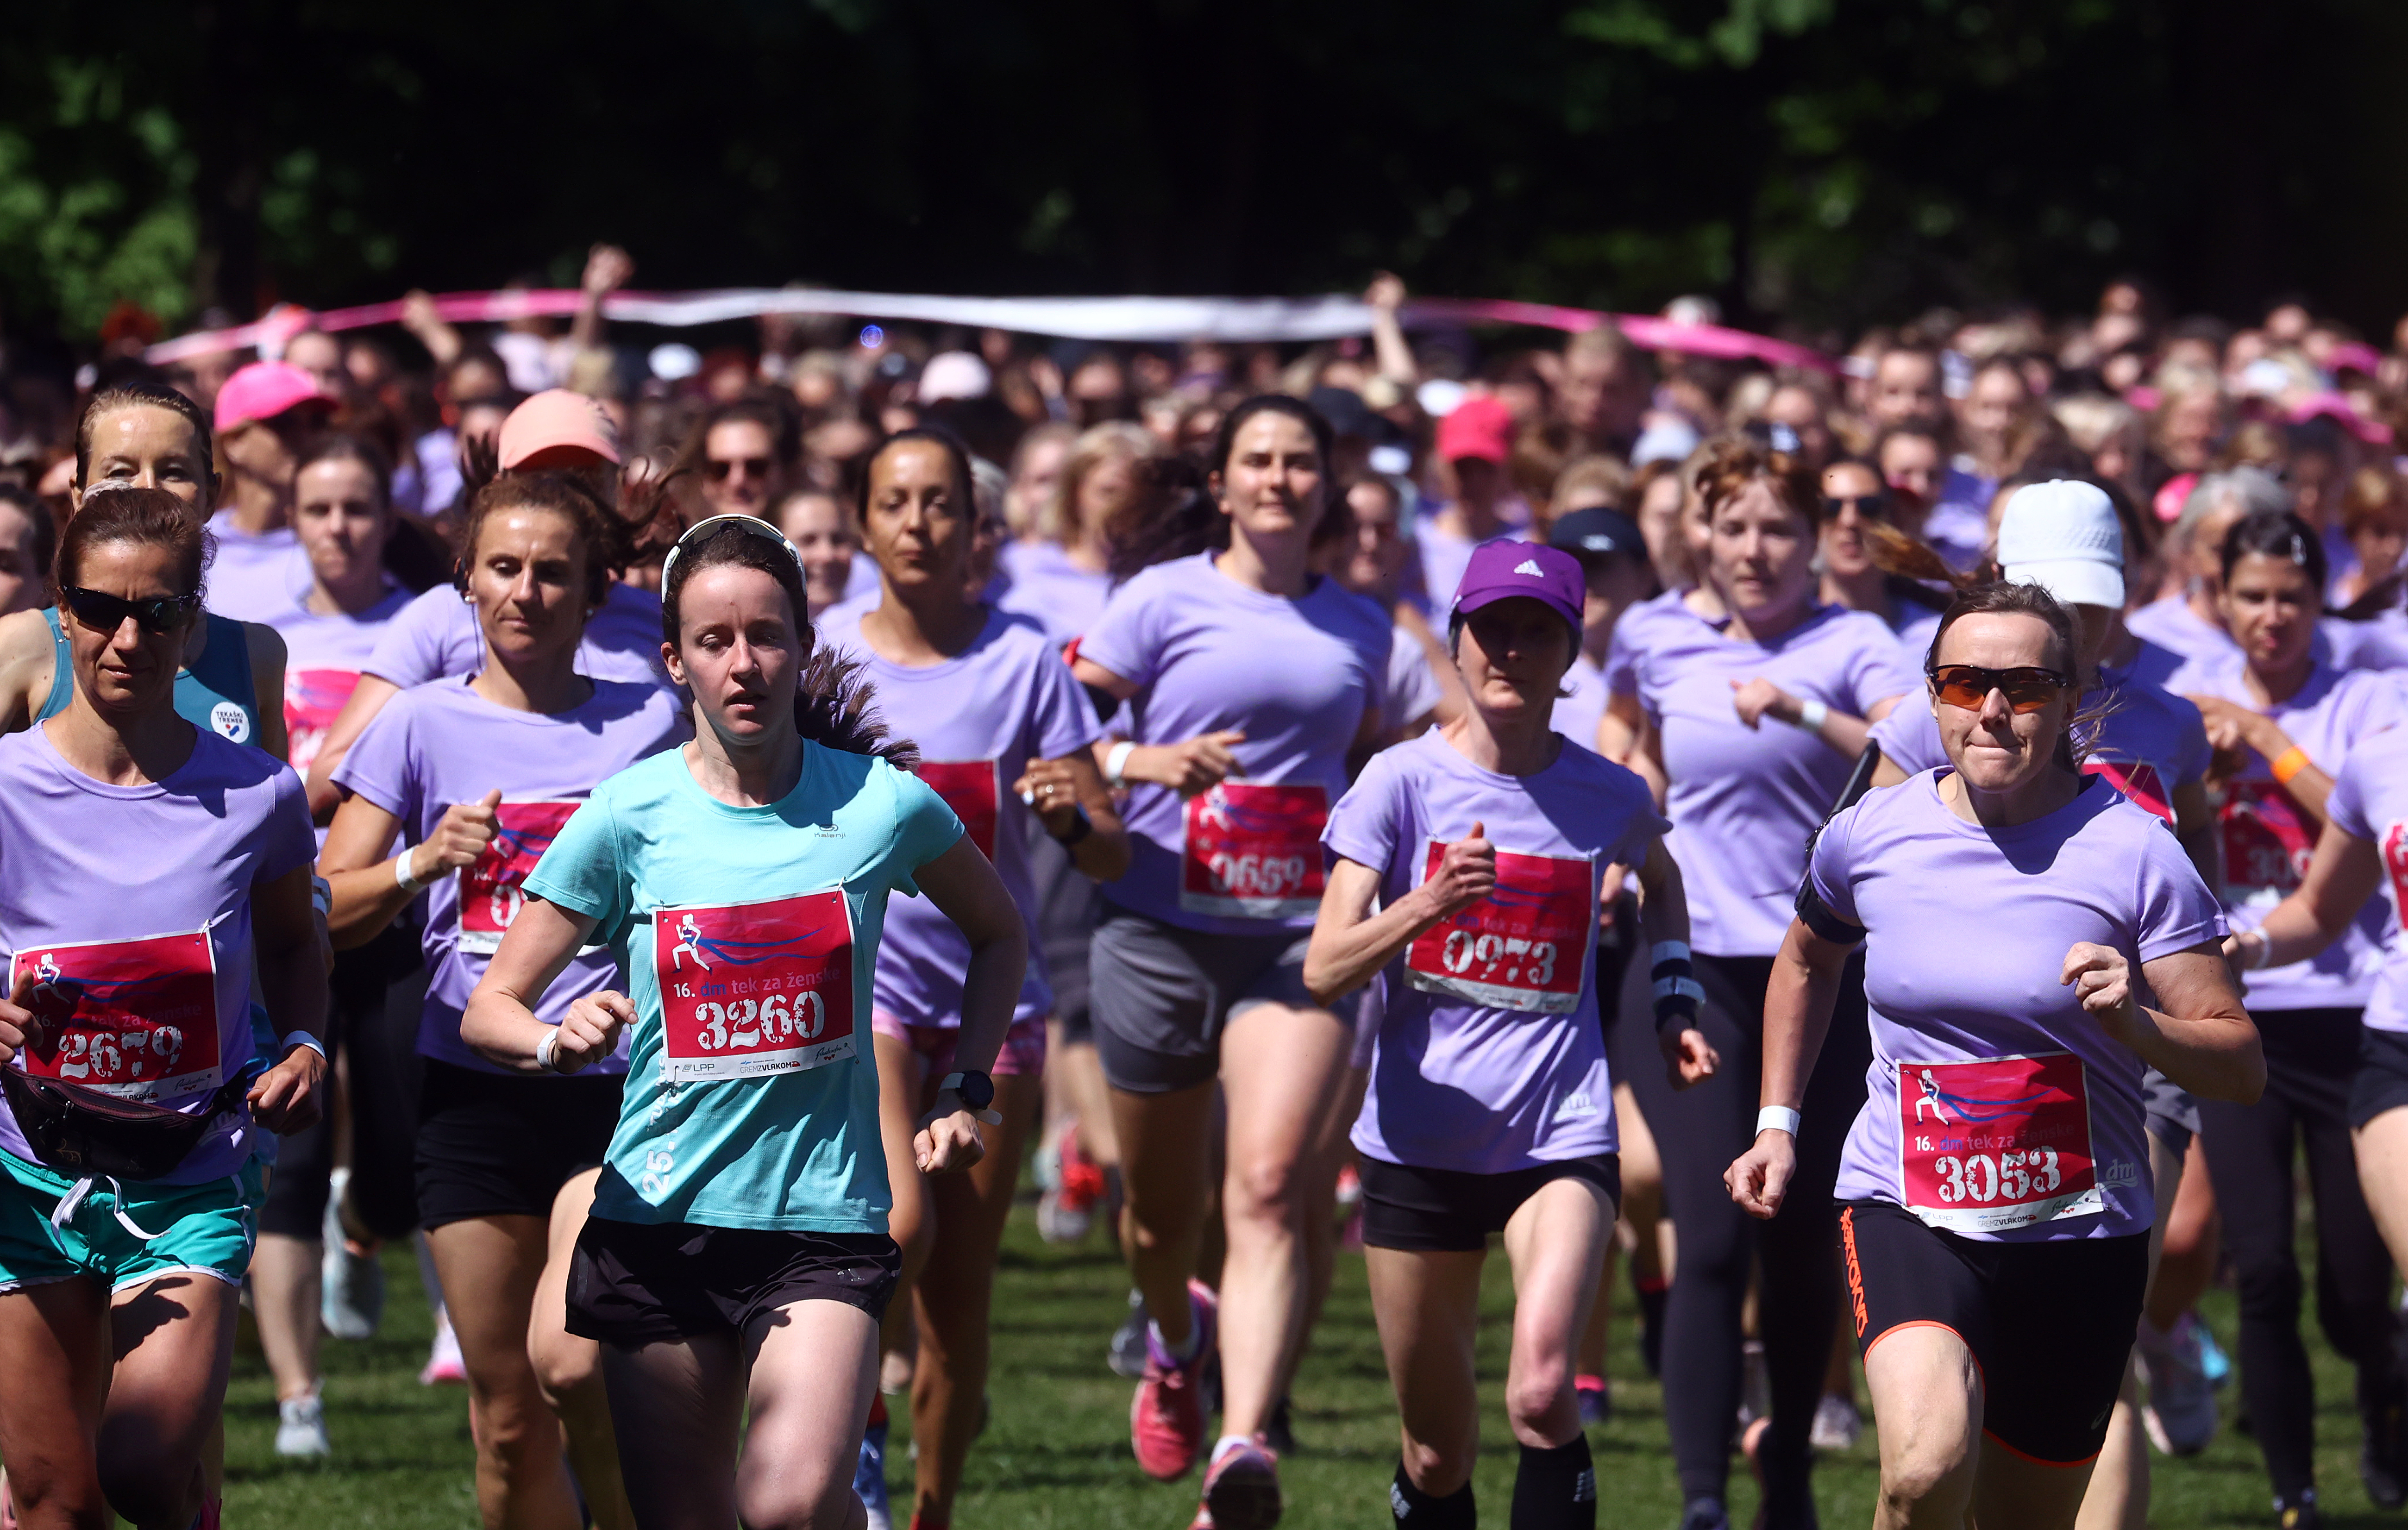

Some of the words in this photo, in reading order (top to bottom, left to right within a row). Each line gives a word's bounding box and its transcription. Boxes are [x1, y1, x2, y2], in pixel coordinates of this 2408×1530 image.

[1442, 930, 1557, 985] 0973
[673, 982, 696, 997] 16.
[700, 982, 727, 997] dm
[731, 977, 758, 994] tek
[763, 977, 782, 991] za
[786, 967, 840, 988] ženske
[122, 1015, 141, 1028] za
[696, 991, 825, 1050] 3260
[58, 1025, 183, 1079] 2679
[693, 1063, 715, 1072] LPP
[740, 1061, 792, 1073] GREMZVLAKOM
[1915, 1135, 1935, 1151] 16.
[1939, 1135, 1963, 1151] dm
[1968, 1134, 1994, 1150] tek
[1997, 1135, 2015, 1148] za
[1935, 1145, 2061, 1203] 3053
[2105, 1159, 2135, 1180] dm
